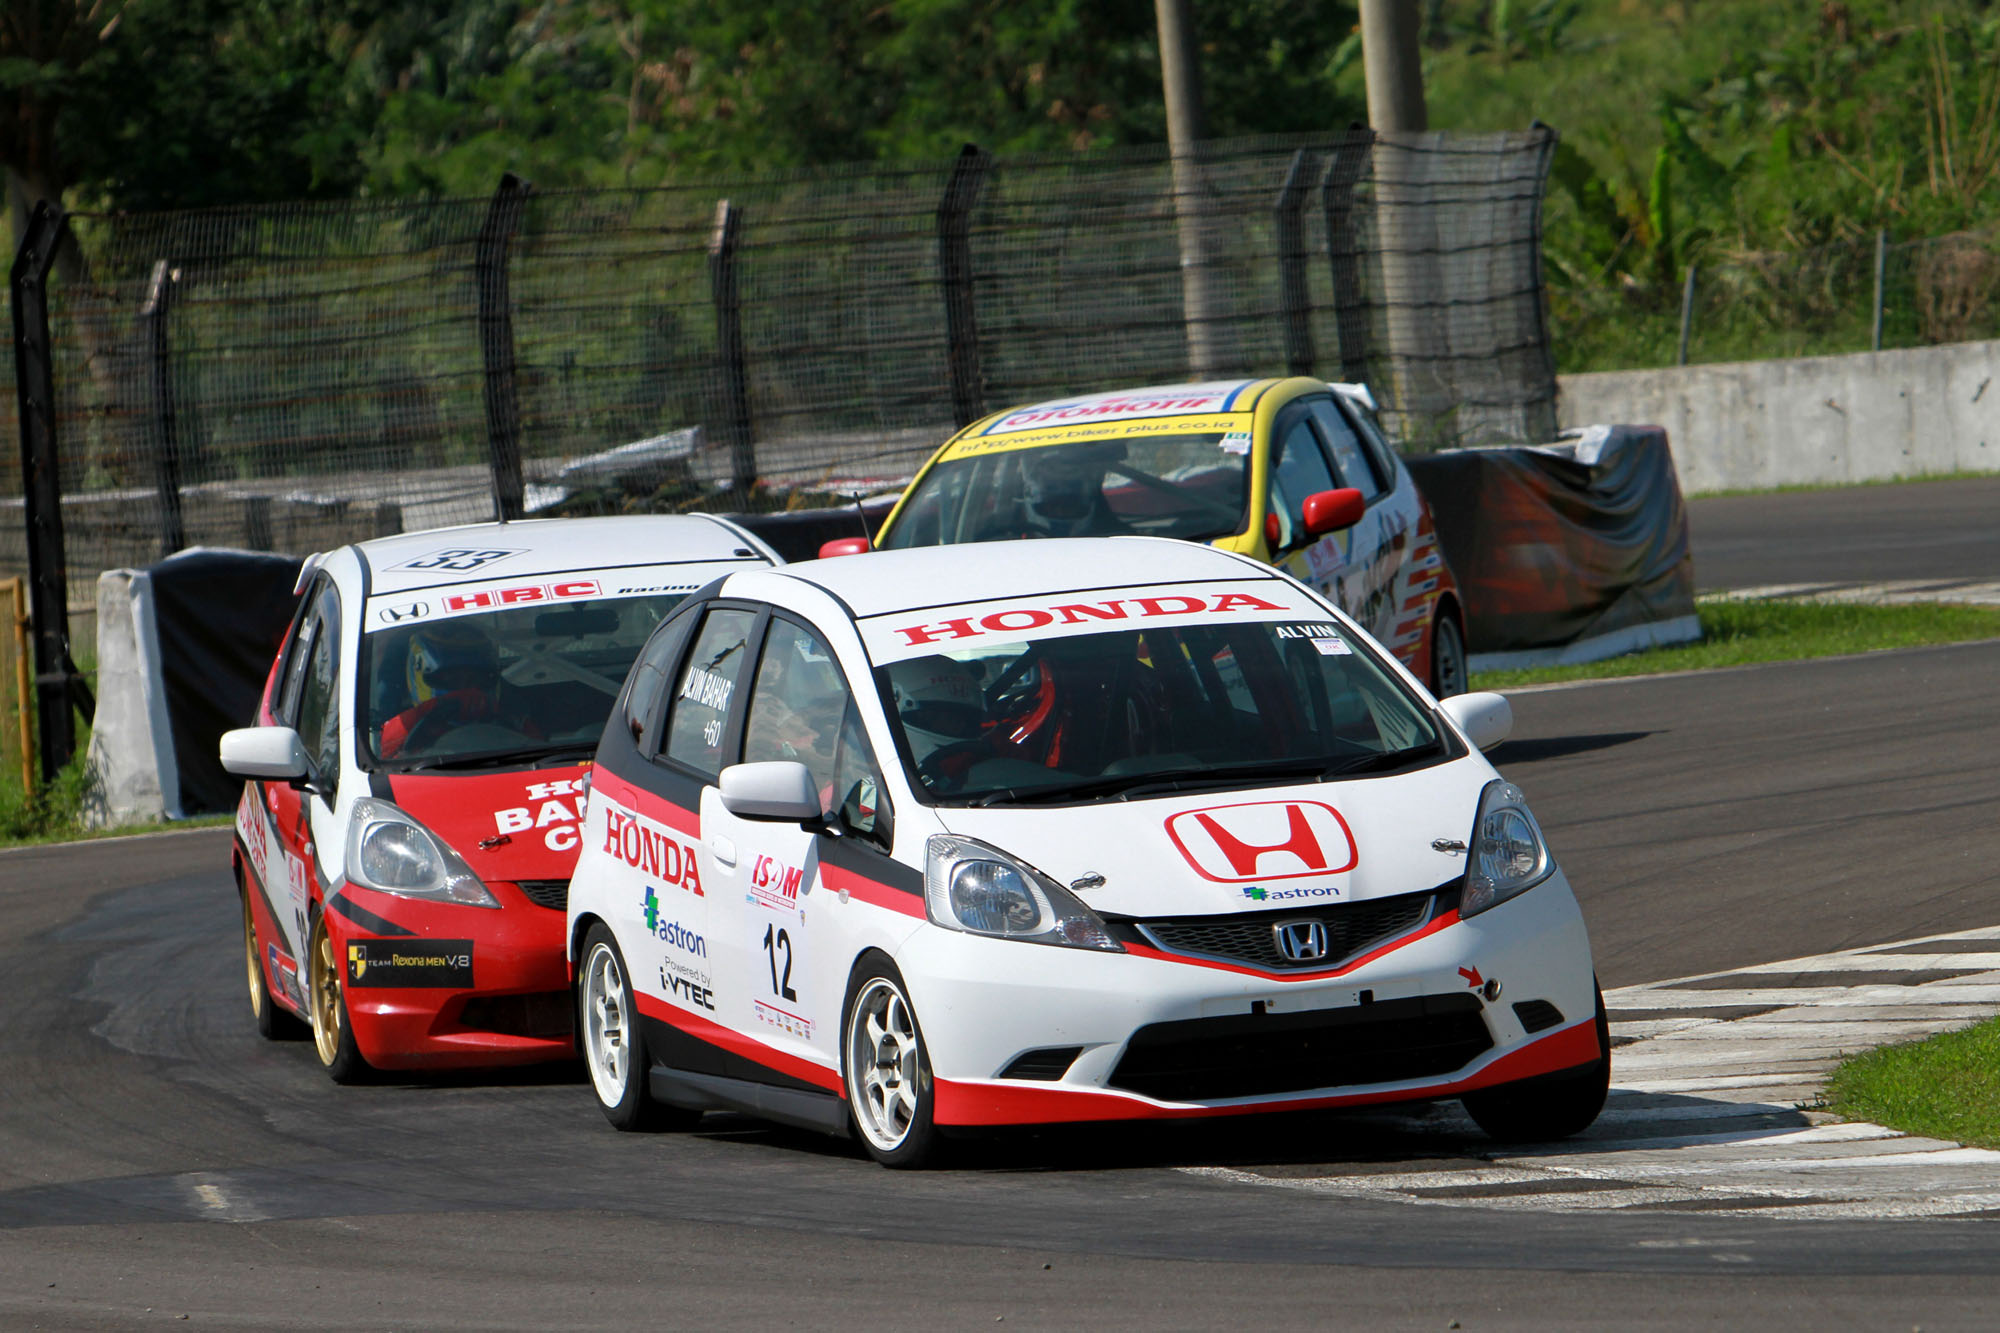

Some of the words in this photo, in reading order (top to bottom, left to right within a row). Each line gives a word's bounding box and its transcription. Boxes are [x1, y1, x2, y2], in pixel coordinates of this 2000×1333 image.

[406, 550, 512, 569] 33
[447, 582, 596, 610] HBC
[618, 584, 701, 594] Racing
[894, 593, 1290, 646] HONDA
[1276, 625, 1337, 639] ALVIN
[681, 666, 707, 702] ALVIN
[701, 673, 731, 712] BAHAR
[704, 720, 720, 748] +60
[544, 822, 584, 852] C
[603, 807, 705, 898] HONDA
[392, 954, 425, 967] Rexona
[425, 957, 446, 967] MEN
[665, 956, 700, 981] Powered
[700, 972, 711, 987] by
[764, 923, 797, 1003] 12
